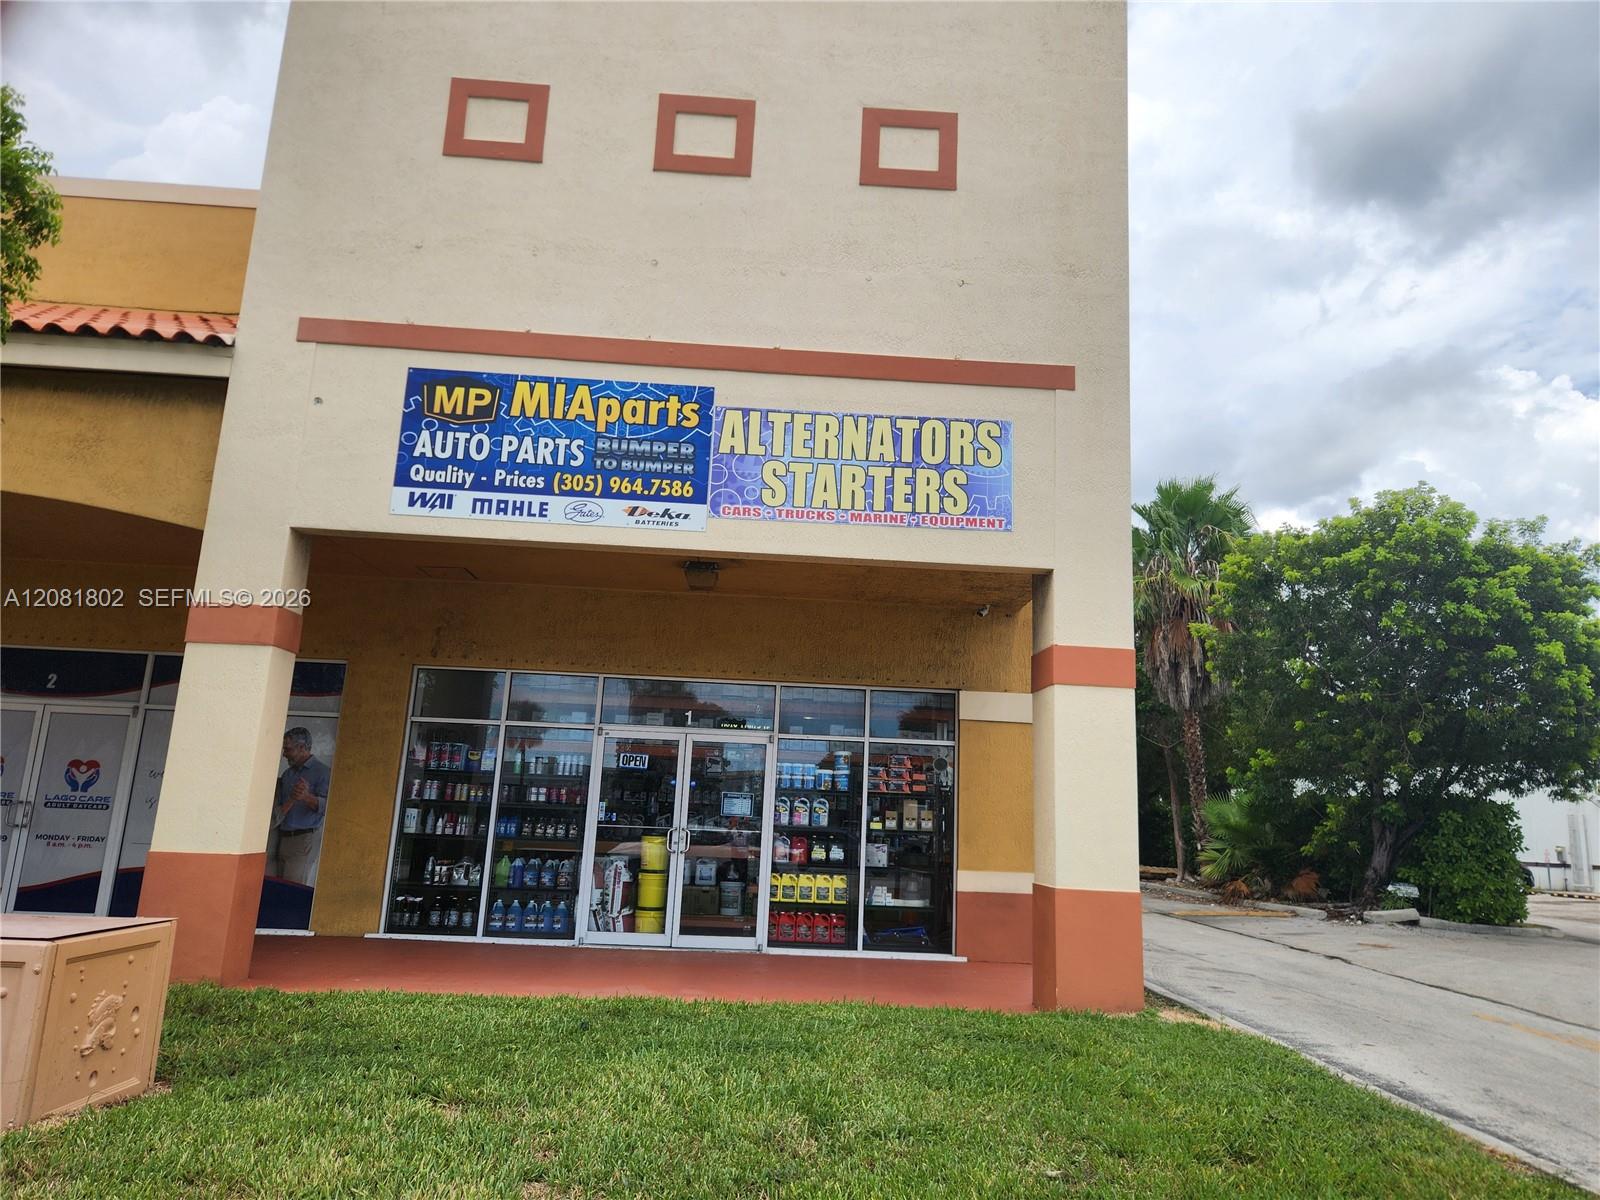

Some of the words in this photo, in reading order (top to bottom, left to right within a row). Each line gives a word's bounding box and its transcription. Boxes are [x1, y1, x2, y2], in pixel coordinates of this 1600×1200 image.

[433, 385, 492, 416] MP
[510, 381, 700, 432] MIAparts
[718, 408, 1003, 468] ALTERNATORS
[413, 430, 490, 461] AUTO
[501, 435, 585, 467] PARTS
[596, 437, 696, 460] BUMPER
[594, 457, 621, 470] TO
[622, 459, 695, 475] BUMPER
[410, 464, 475, 486] Quality
[494, 470, 545, 489] Prices
[553, 471, 603, 497] (305)
[610, 477, 694, 498] 964.7586
[760, 459, 969, 515] STARTERS
[408, 492, 455, 512] WAI
[471, 498, 549, 518] MAHLE
[624, 505, 691, 520] Deka
[721, 505, 762, 517] CARS
[776, 508, 836, 521] TRUCKS
[850, 511, 907, 524] MARINE
[921, 515, 1005, 529] EQUIPMENT
[635, 519, 680, 527] BATTERIES
[46, 673, 57, 689] 2
[685, 710, 692, 725] 1
[621, 754, 647, 768] OPEN
[79, 795, 112, 803] CARE
[77, 835, 106, 843] FRIDAY
